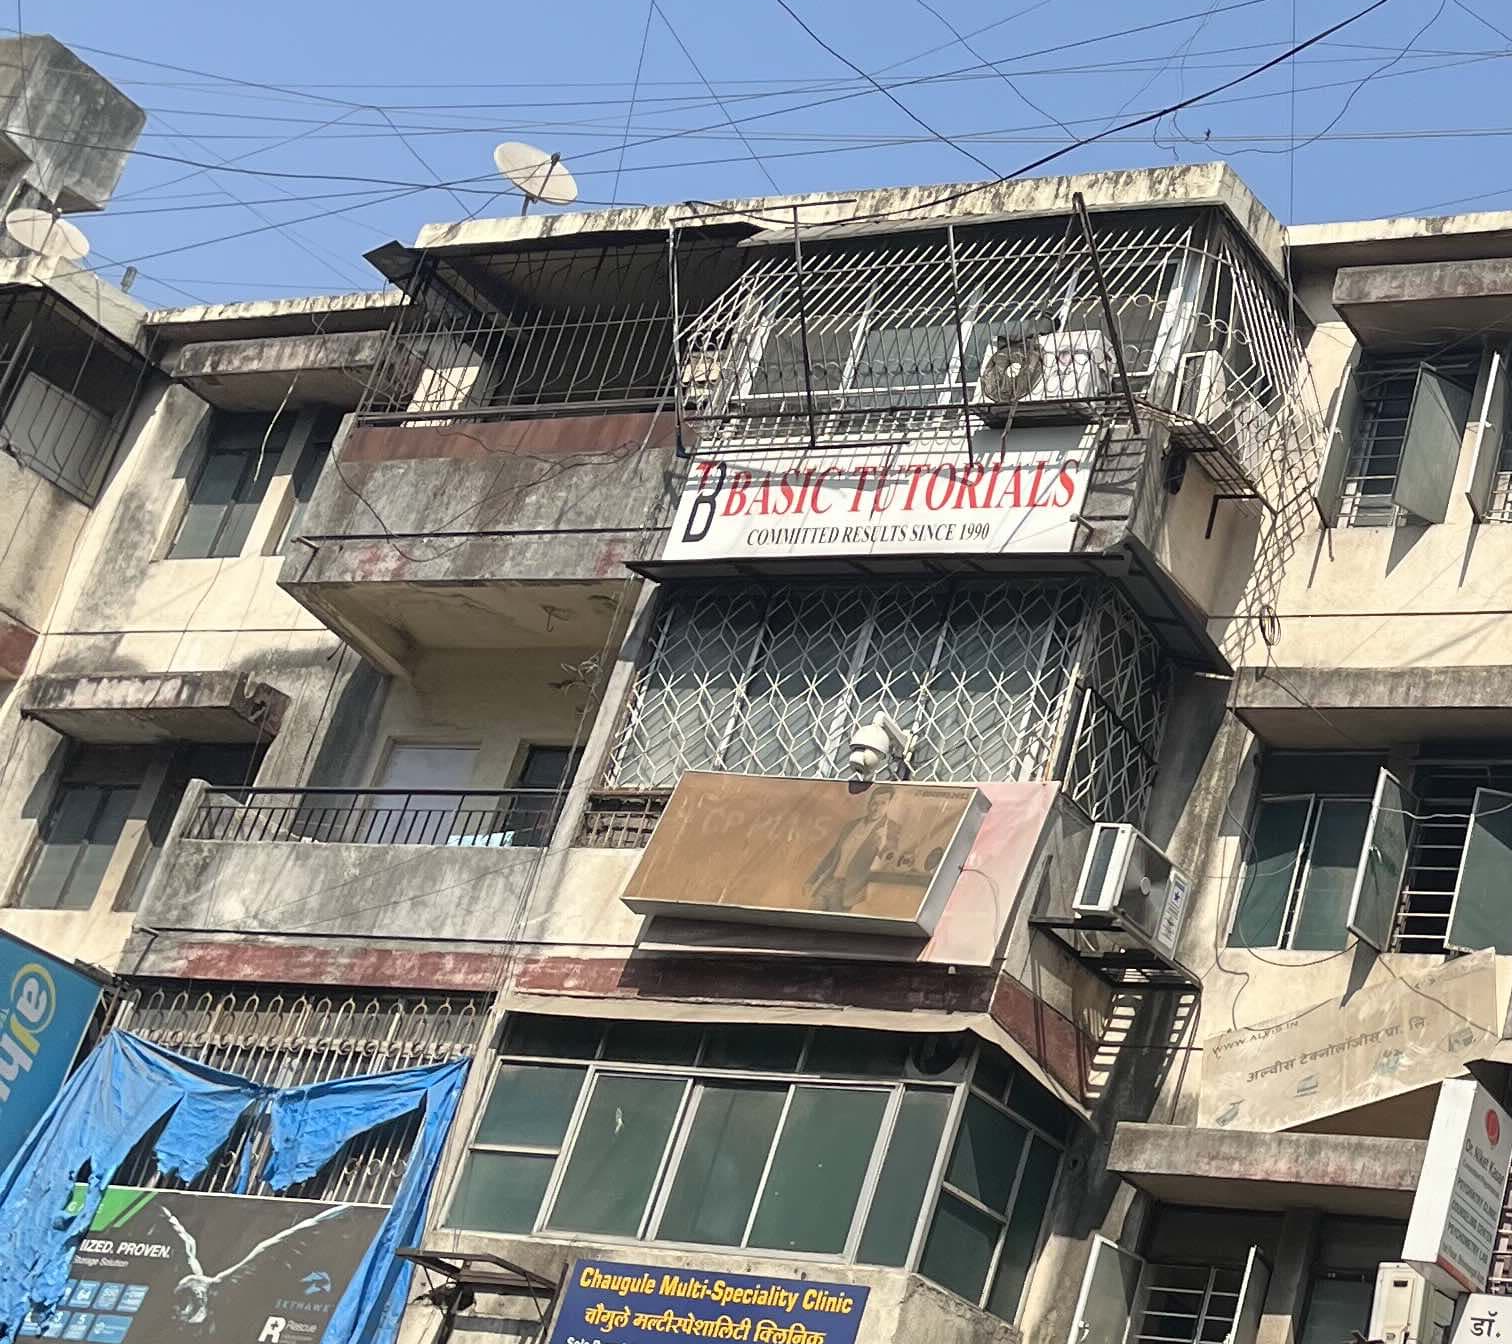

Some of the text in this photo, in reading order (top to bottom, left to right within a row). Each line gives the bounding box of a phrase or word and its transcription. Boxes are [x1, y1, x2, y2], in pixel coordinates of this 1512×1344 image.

[721, 458, 1081, 517] BASIC TUTORIALS
[747, 523, 990, 546] COMMITTED RESULTS SINCE 1990
[117, 1242, 171, 1259] PROVEN.
[579, 1267, 854, 1314] Chaugule Multi-Speciality Clinic
[584, 1303, 630, 1332] चौगुले
[1470, 1311, 1501, 1338] डॉ.
